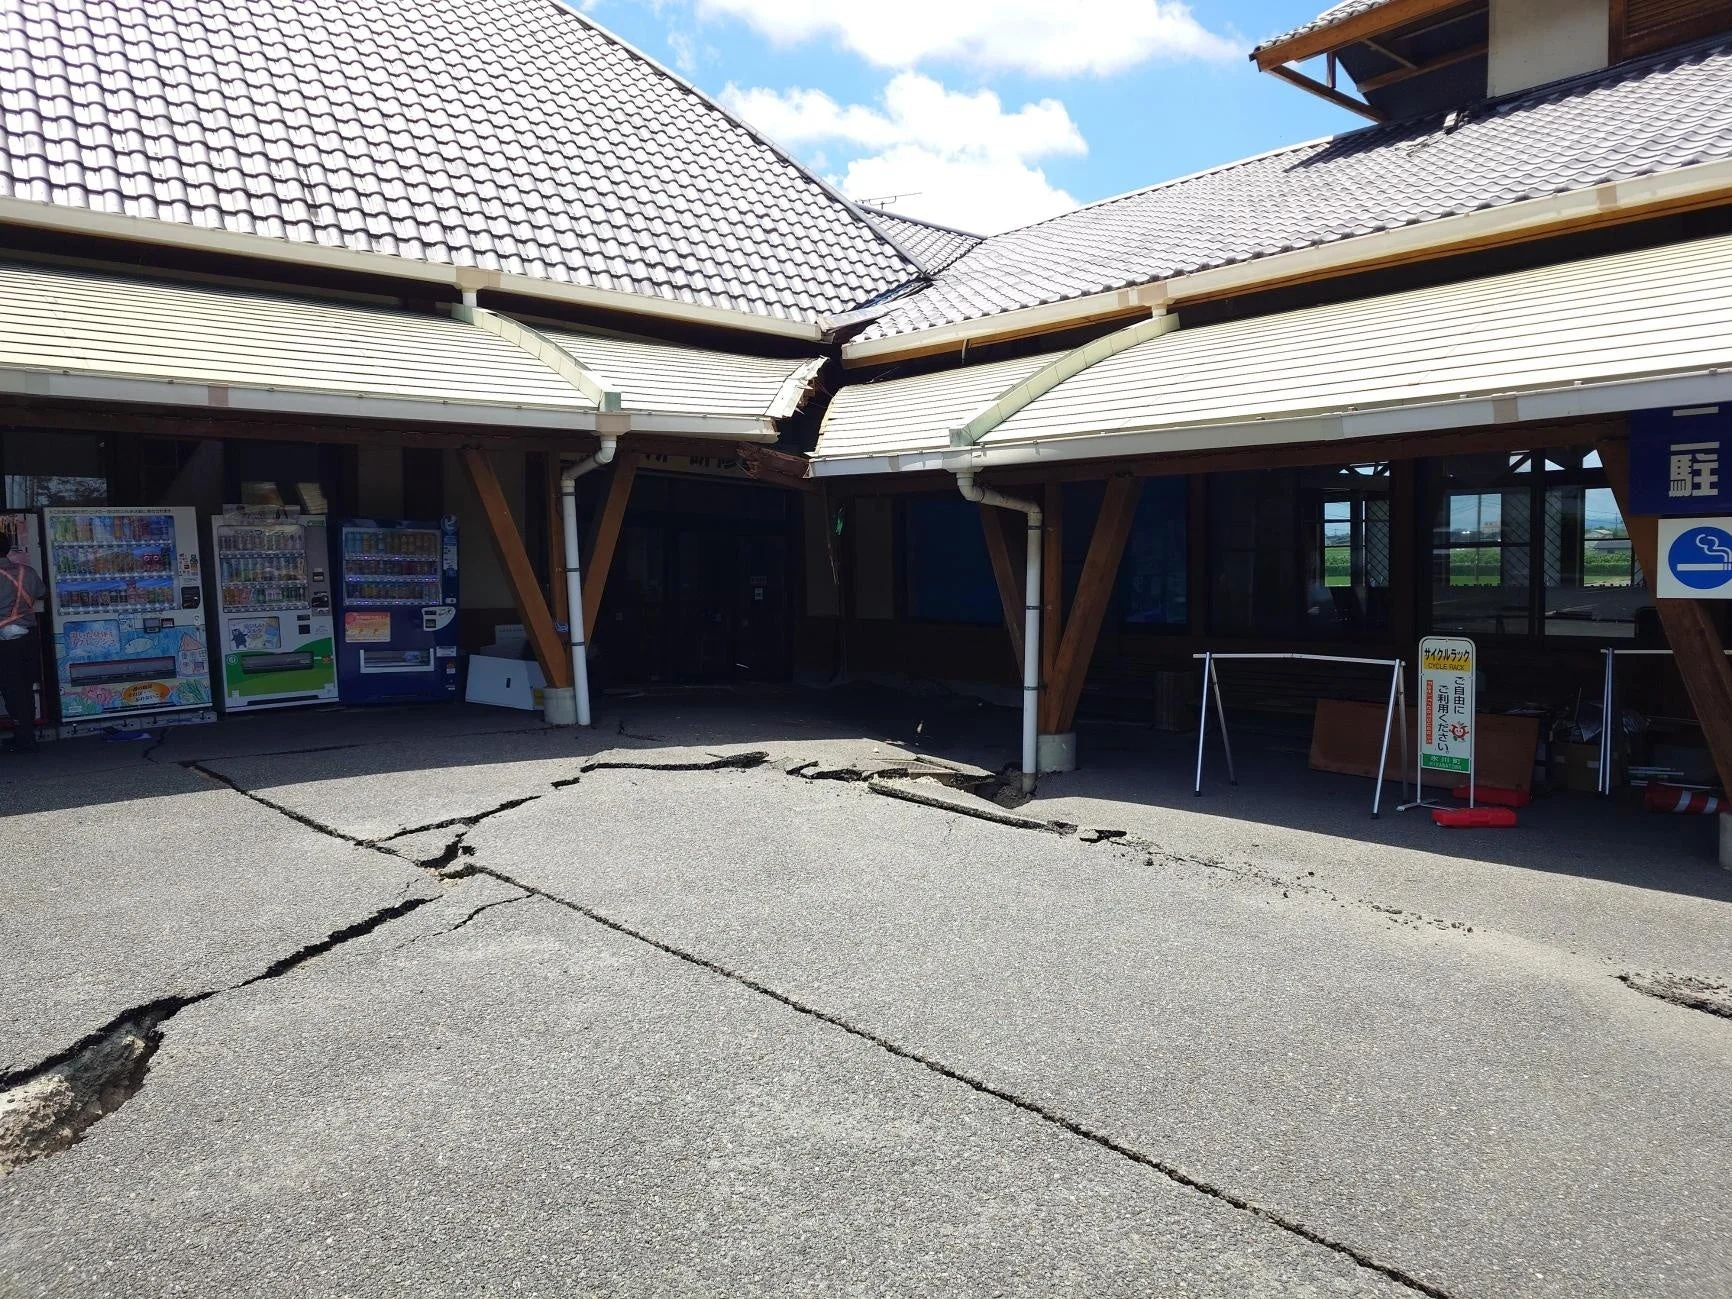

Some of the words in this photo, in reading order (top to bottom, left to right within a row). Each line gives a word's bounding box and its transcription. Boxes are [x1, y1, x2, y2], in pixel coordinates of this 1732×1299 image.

[1669, 453, 1719, 497] 駐
[1424, 648, 1470, 662] サイクルラック
[1453, 677, 1465, 714] ご自由に
[1437, 685, 1449, 754] ご利用ください。
